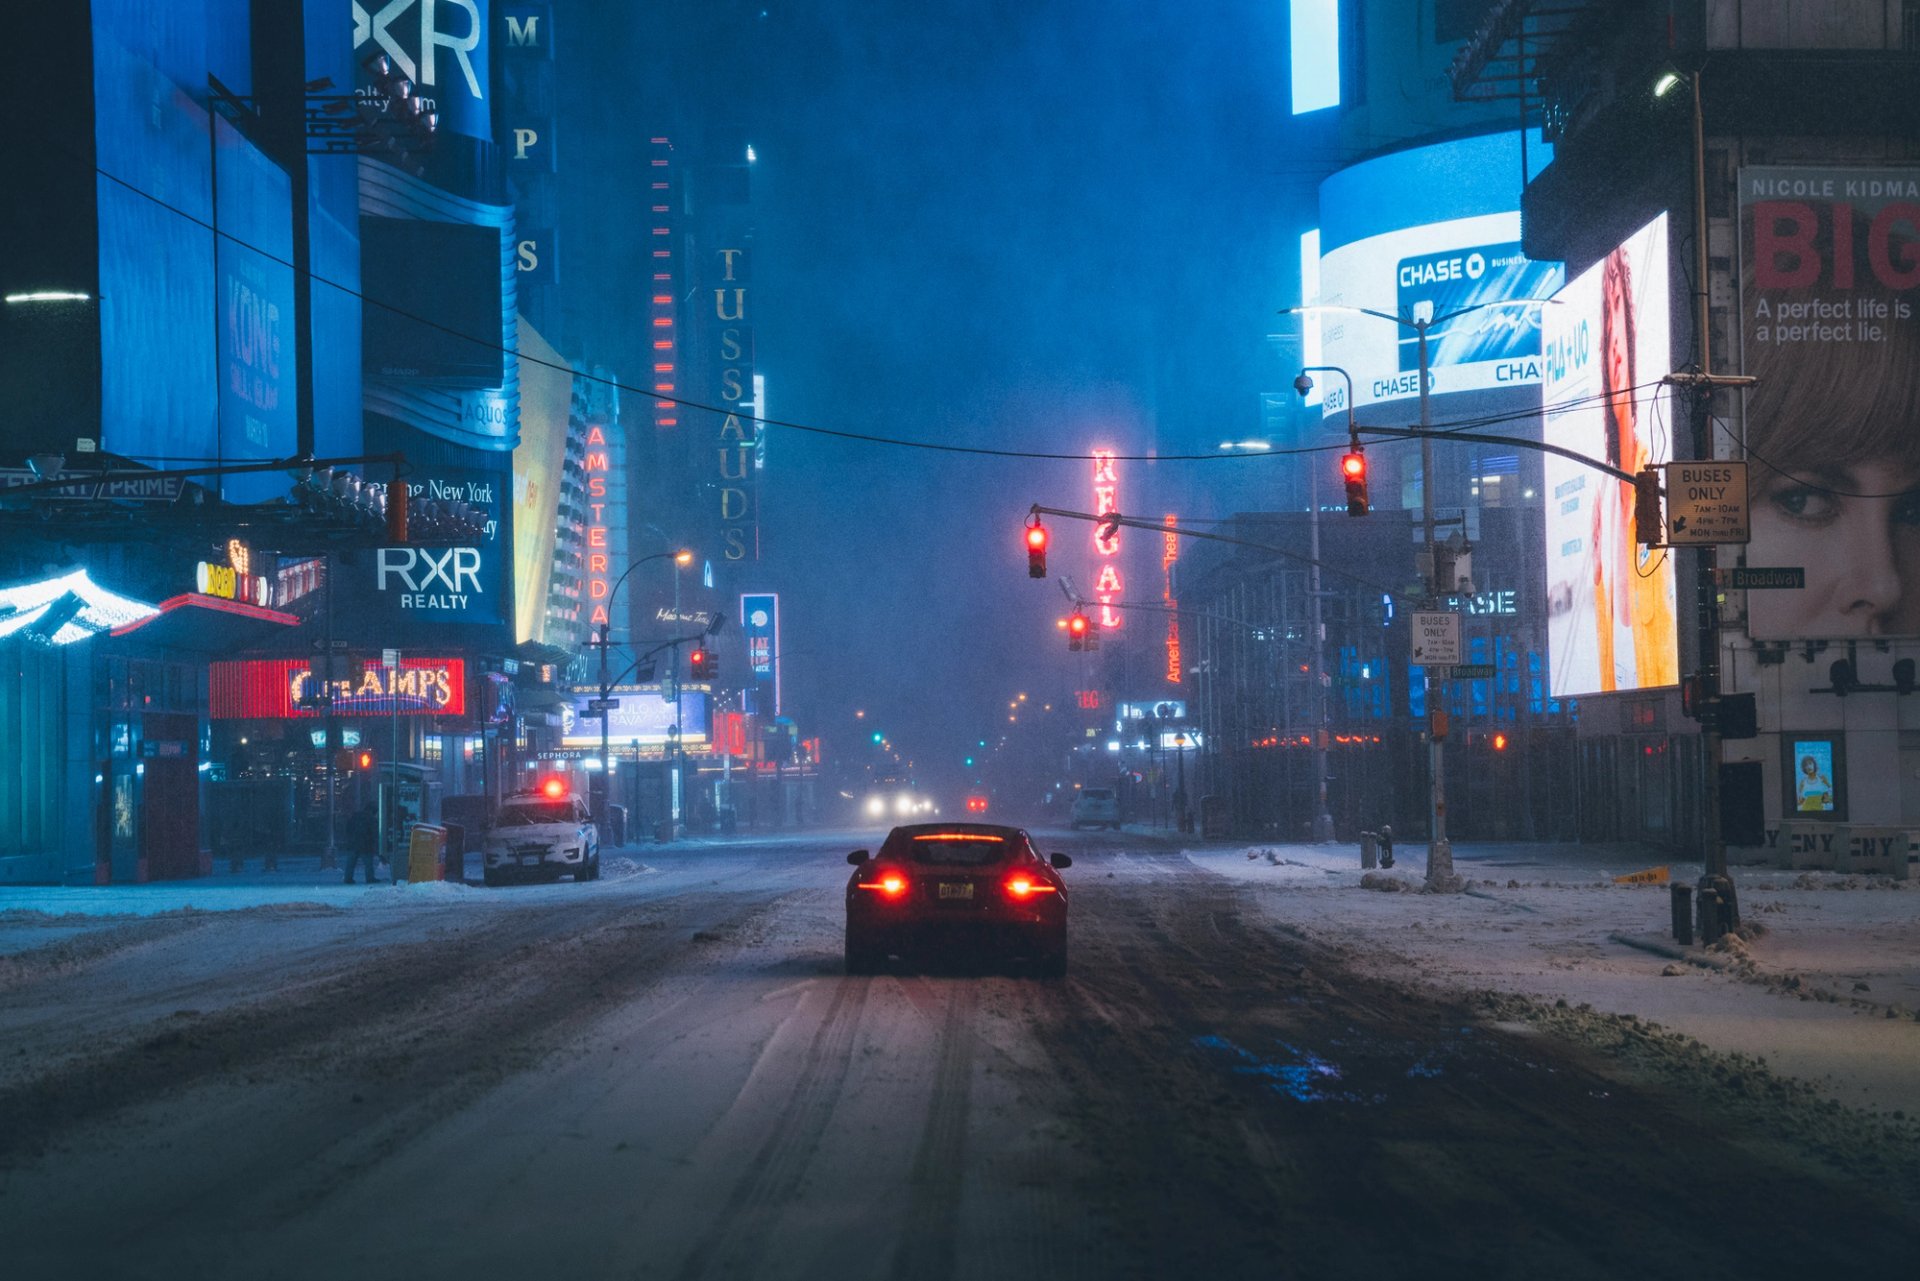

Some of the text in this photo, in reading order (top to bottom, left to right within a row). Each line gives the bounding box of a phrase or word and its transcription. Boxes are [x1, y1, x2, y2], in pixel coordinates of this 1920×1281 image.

[1752, 179, 1834, 197] NICOLE
[1754, 201, 1920, 290] BIG
[1400, 258, 1463, 288] CHASE
[1755, 299, 1911, 323] A perfect life is
[1756, 322, 1888, 346] a perfect lie.
[1495, 360, 1542, 382] CHA
[1373, 375, 1419, 398] CHASE
[464, 404, 508, 426] AQUOS
[108, 476, 179, 497] PRIME
[1682, 469, 1732, 483] BUSES
[428, 479, 464, 500] New
[467, 481, 493, 503] York
[1688, 487, 1726, 500] ONLY
[1091, 449, 1122, 628] REGAL
[376, 547, 483, 593] RXR
[1737, 571, 1800, 588] Broadway
[401, 594, 468, 610] REALTY
[1420, 616, 1450, 626] BUSES
[1423, 628, 1447, 637] ONLY
[537, 752, 581, 760] SEPHORA
